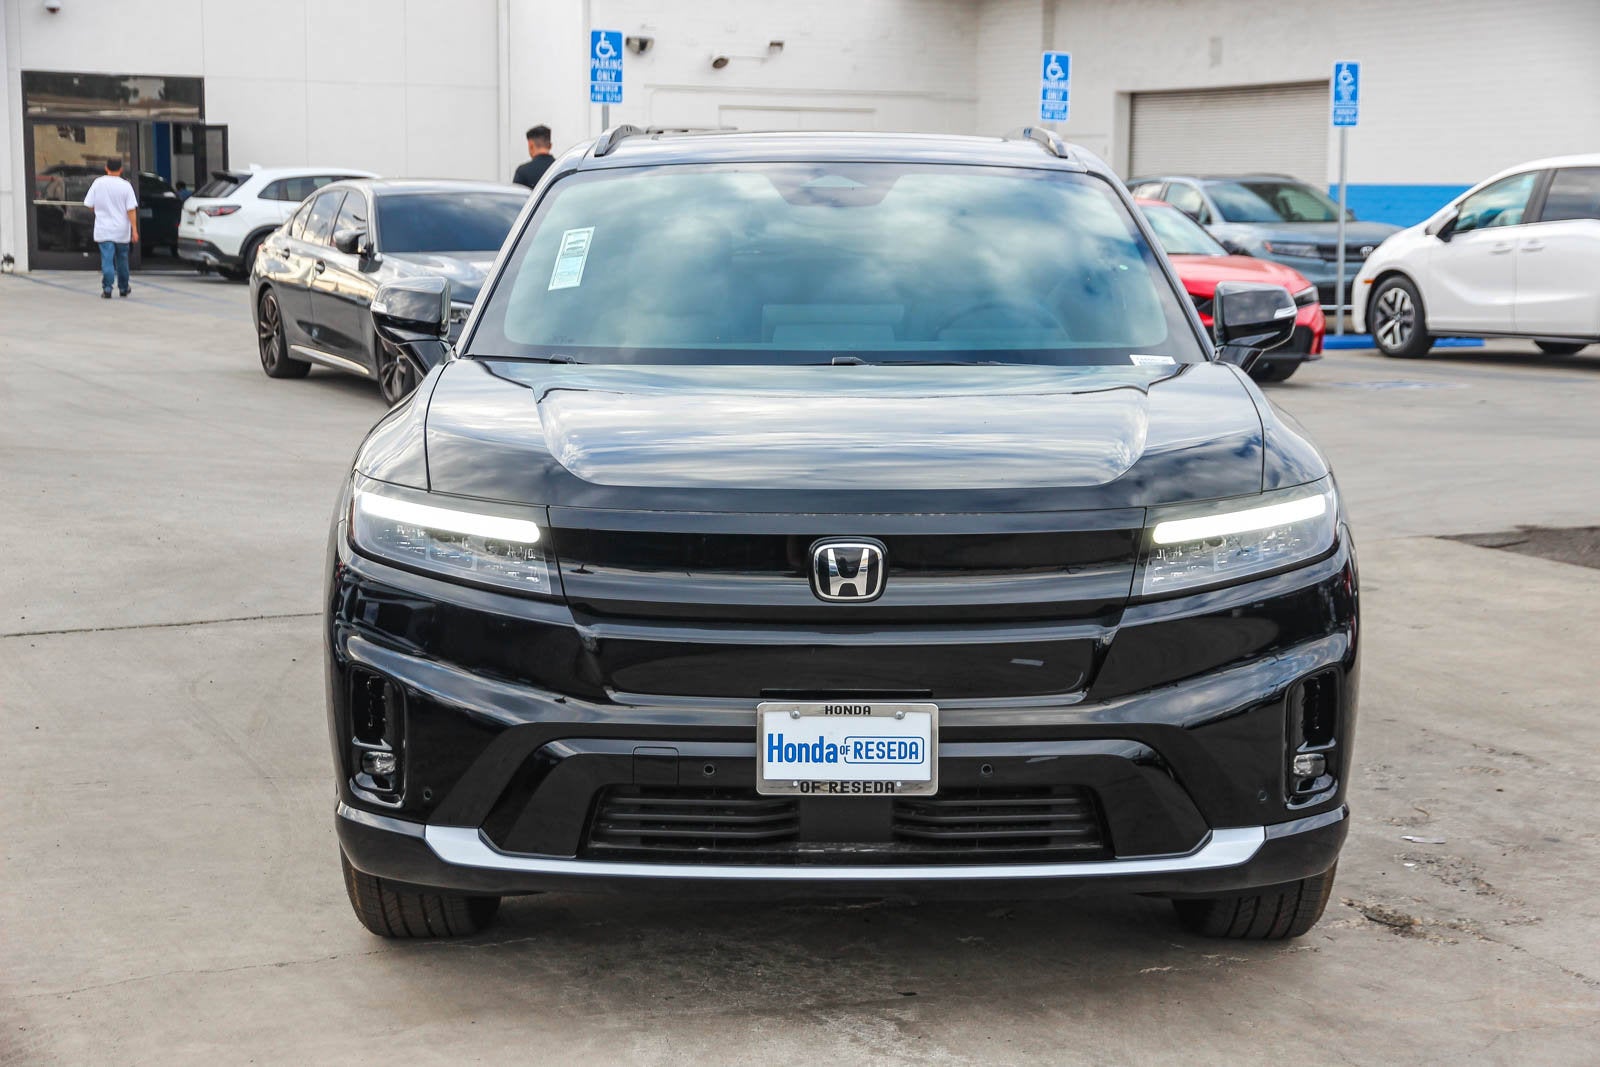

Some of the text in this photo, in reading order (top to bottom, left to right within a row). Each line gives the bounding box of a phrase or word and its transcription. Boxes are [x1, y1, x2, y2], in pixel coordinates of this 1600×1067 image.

[591, 58, 623, 70] PARKING
[597, 69, 616, 81] ONLY
[824, 705, 872, 715] HONDA
[767, 733, 919, 763] Honda OF RESEDA
[800, 781, 895, 794] OF RESEDA
